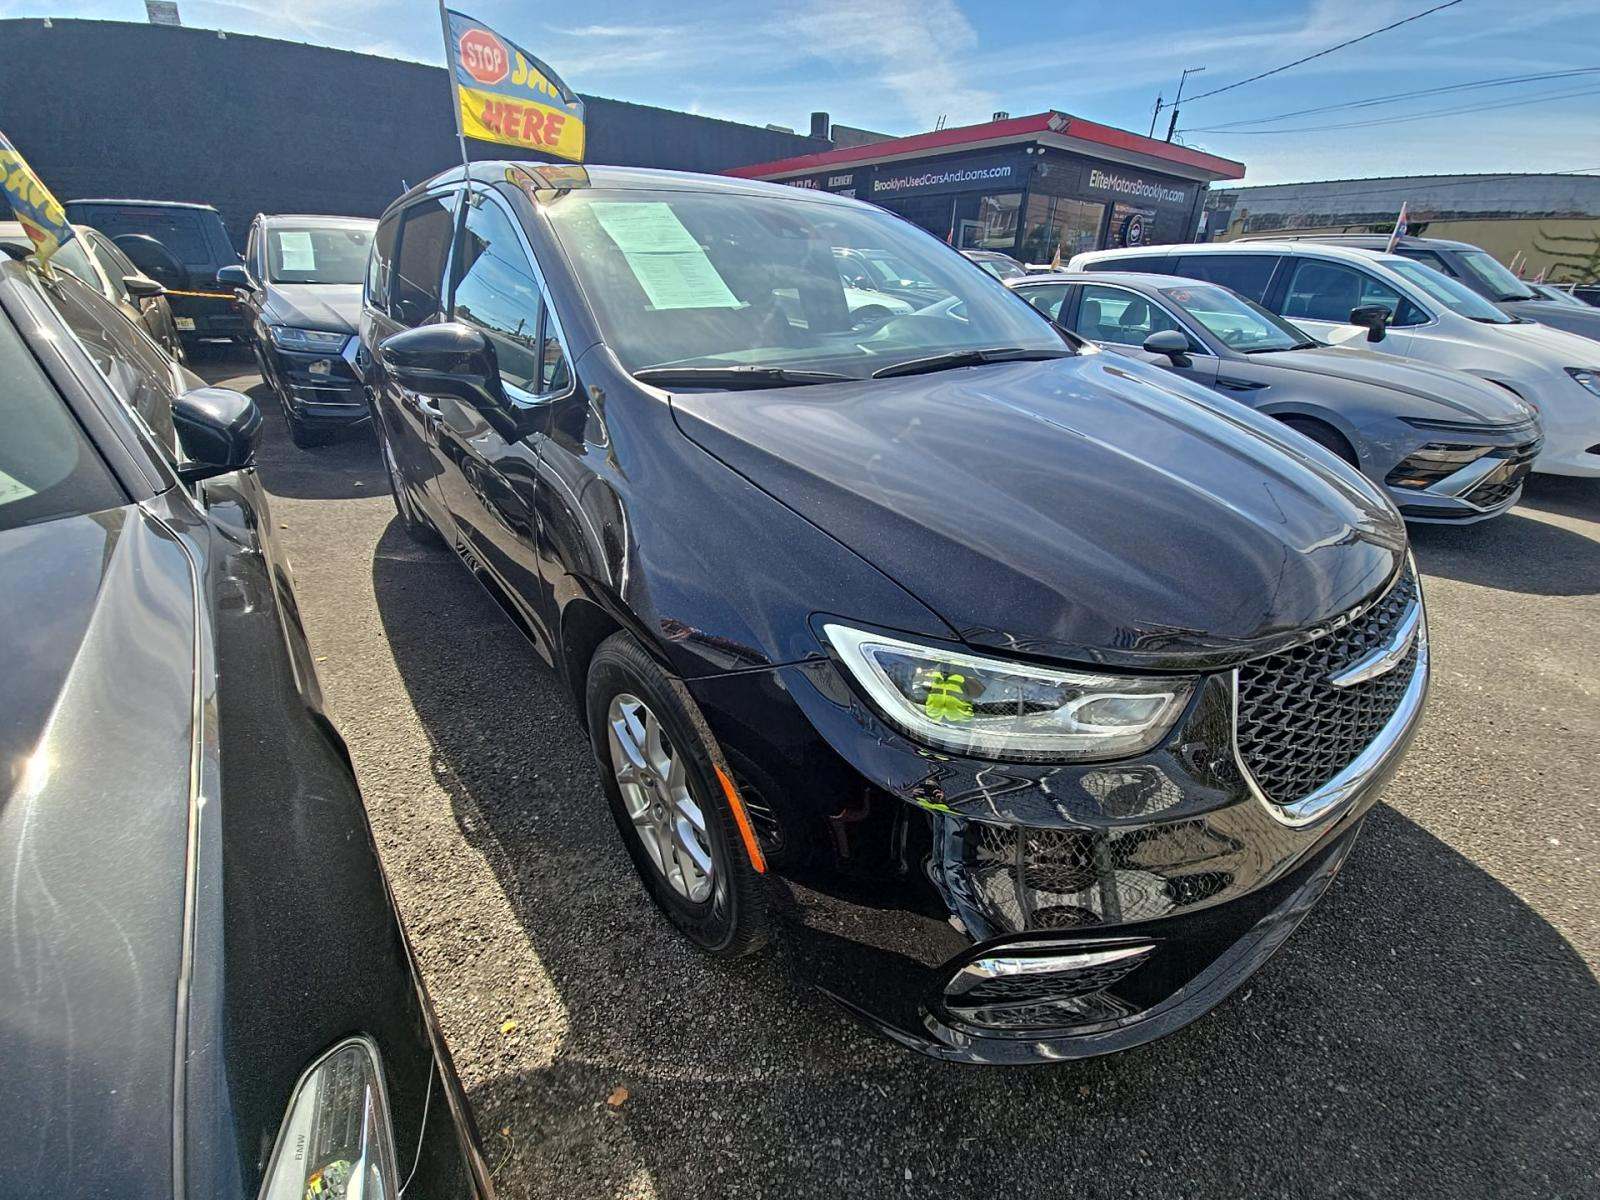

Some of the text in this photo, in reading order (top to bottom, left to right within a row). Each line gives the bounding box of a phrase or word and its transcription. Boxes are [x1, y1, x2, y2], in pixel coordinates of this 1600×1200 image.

[466, 42, 501, 72] STOP
[481, 99, 566, 146] HERE
[873, 165, 1011, 192] BrooklynUsedCarsAndLoans.com
[1088, 169, 1185, 203] EliteMotorsBrooklyn.com
[295, 1134, 305, 1161] BMW
